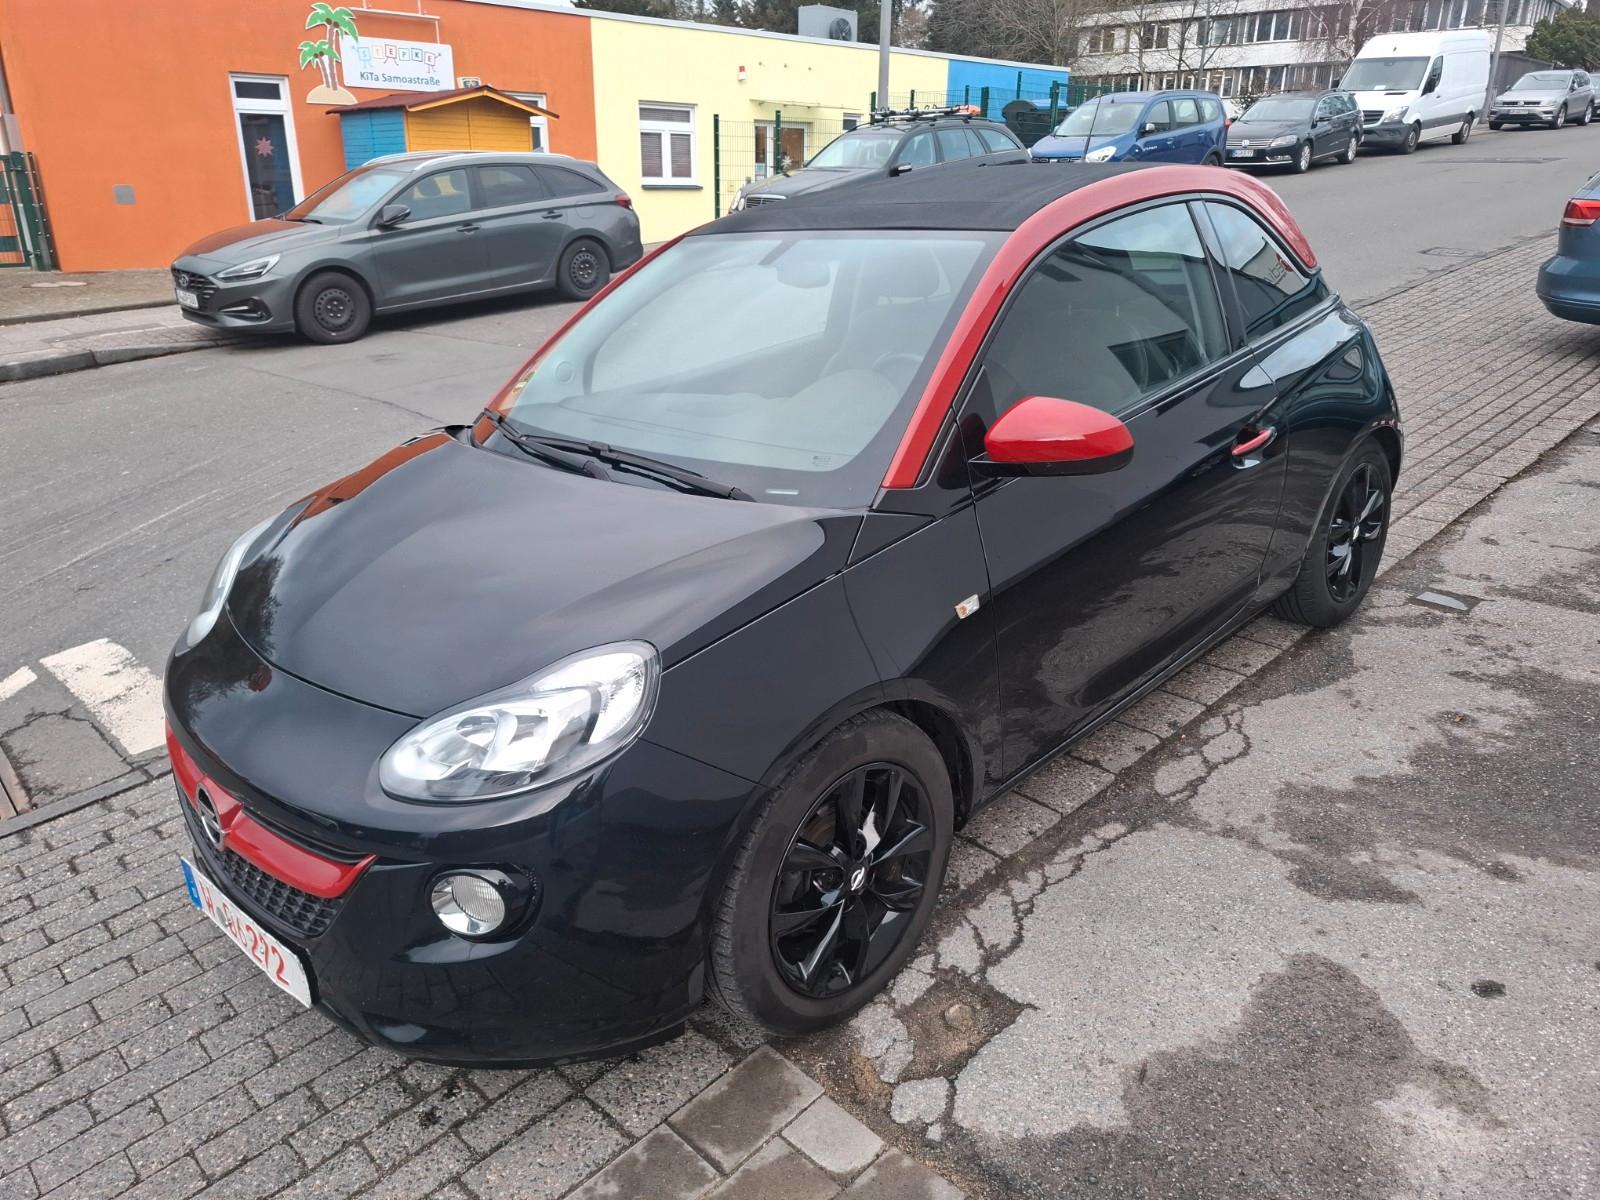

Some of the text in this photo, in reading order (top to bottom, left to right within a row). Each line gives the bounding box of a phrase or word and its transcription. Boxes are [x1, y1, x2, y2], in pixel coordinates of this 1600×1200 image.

[360, 46, 434, 64] STEPKE
[360, 71, 441, 86] KiTa Samoastraße
